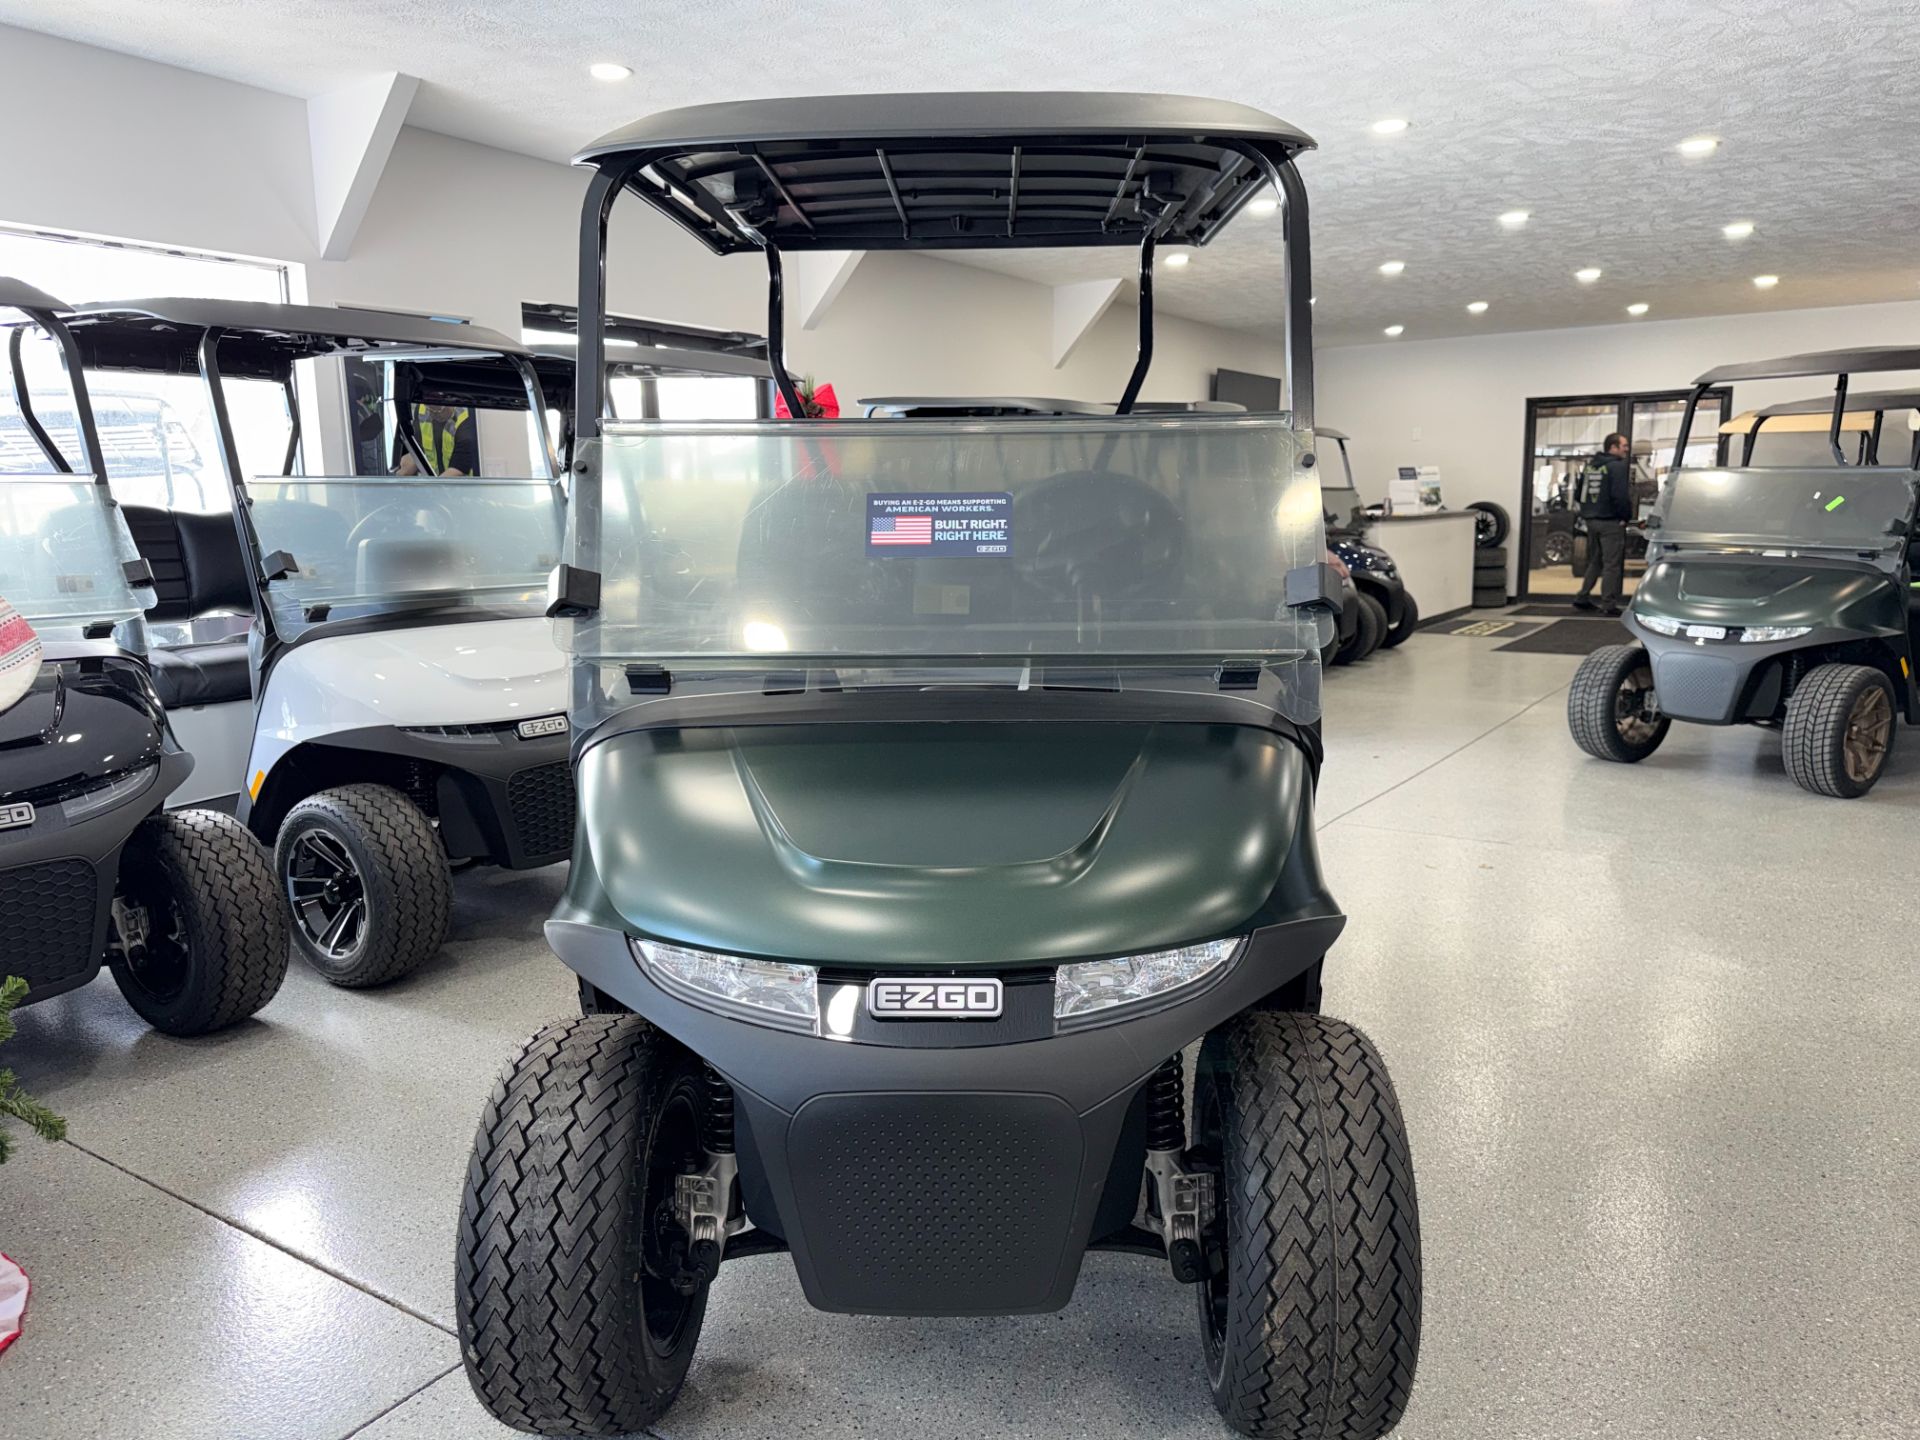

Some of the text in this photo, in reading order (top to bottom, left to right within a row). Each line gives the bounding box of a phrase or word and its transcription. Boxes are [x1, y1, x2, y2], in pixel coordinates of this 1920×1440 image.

[934, 519, 1008, 530] BUILT RIGHT.
[934, 530, 1008, 541] RIGHT HERE.
[521, 718, 566, 735] EZGO
[876, 984, 996, 1010] EZGO
